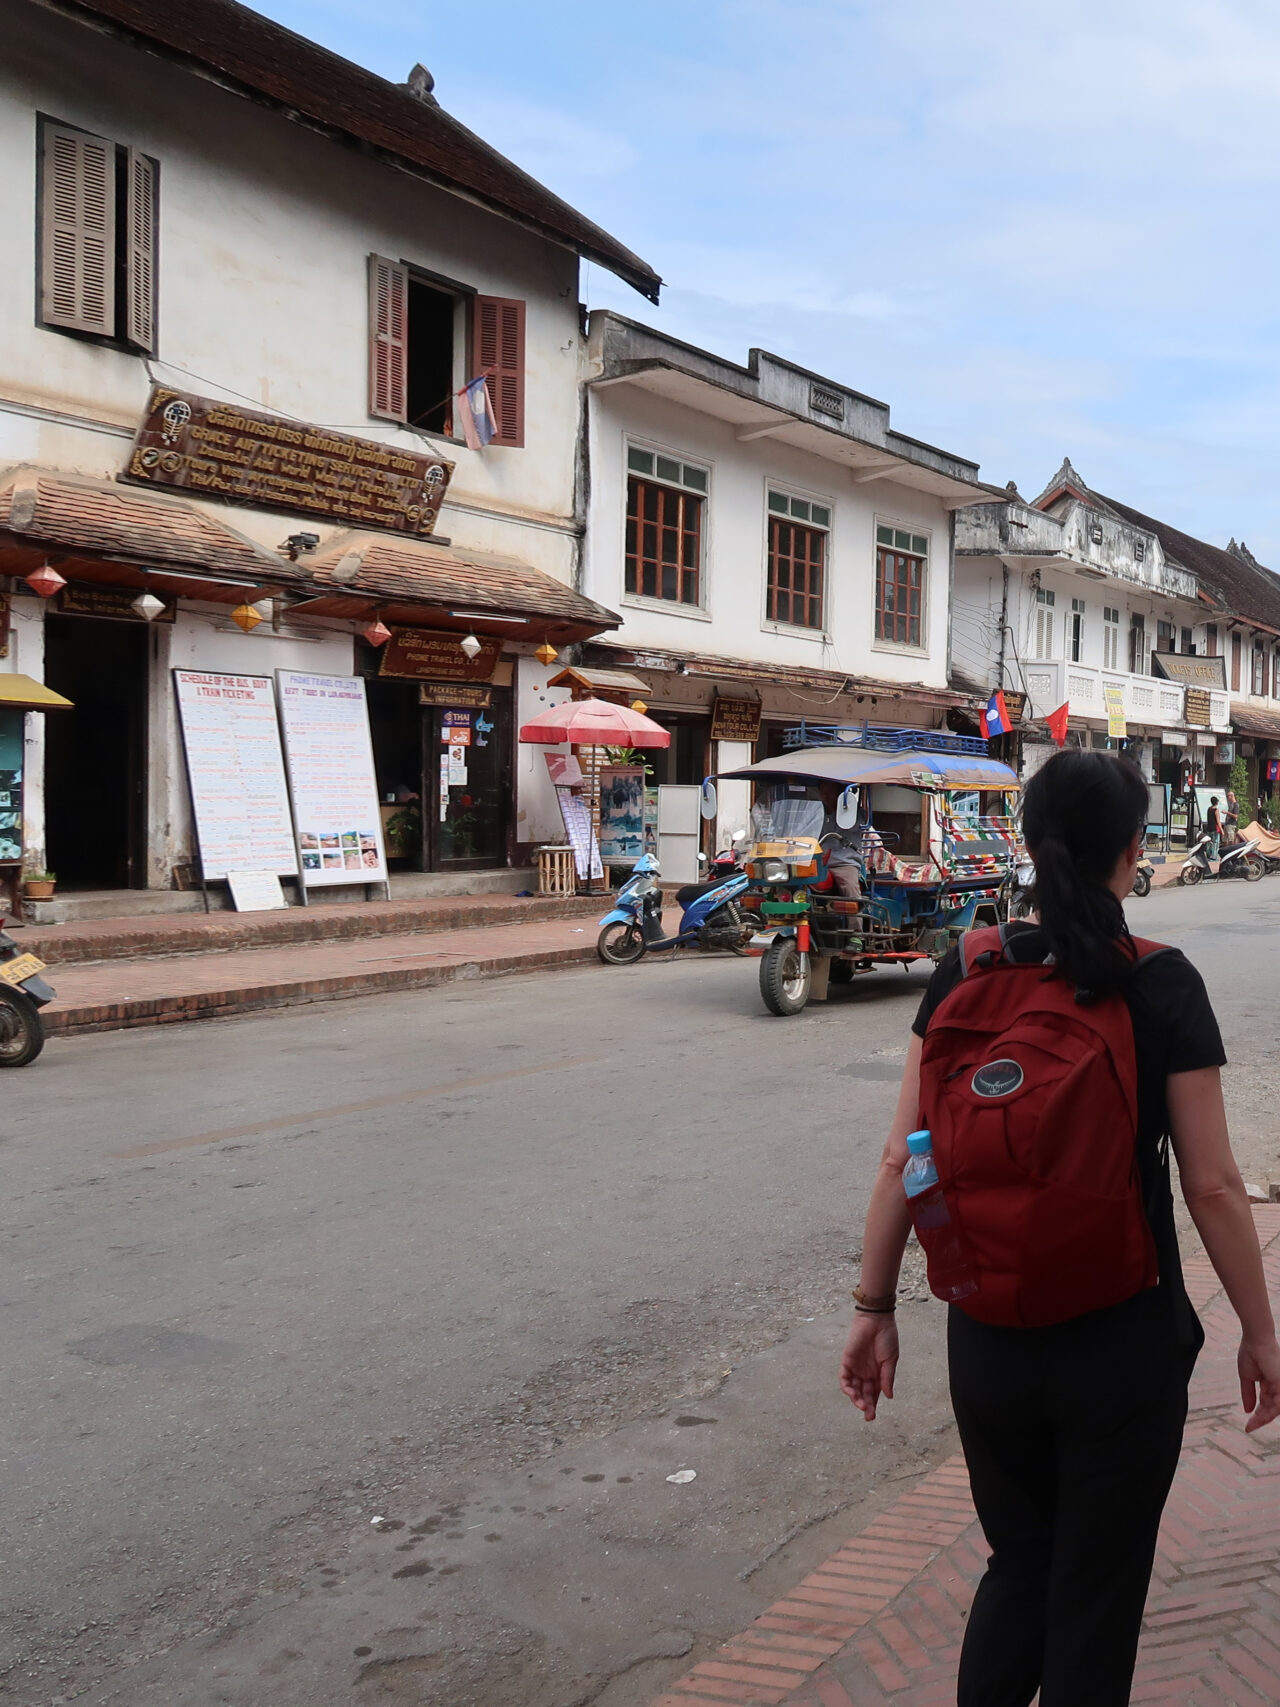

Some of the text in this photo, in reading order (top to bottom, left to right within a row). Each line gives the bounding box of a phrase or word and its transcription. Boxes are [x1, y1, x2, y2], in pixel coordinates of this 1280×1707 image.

[191, 428, 232, 445] GRACE
[234, 437, 256, 451] AIR
[260, 443, 324, 468] TICKETING
[330, 458, 371, 480] SERVICE
[180, 674, 213, 685] SCHEDULE
[214, 677, 222, 687] OF
[223, 677, 235, 687] THE
[453, 713, 470, 721] THAI
